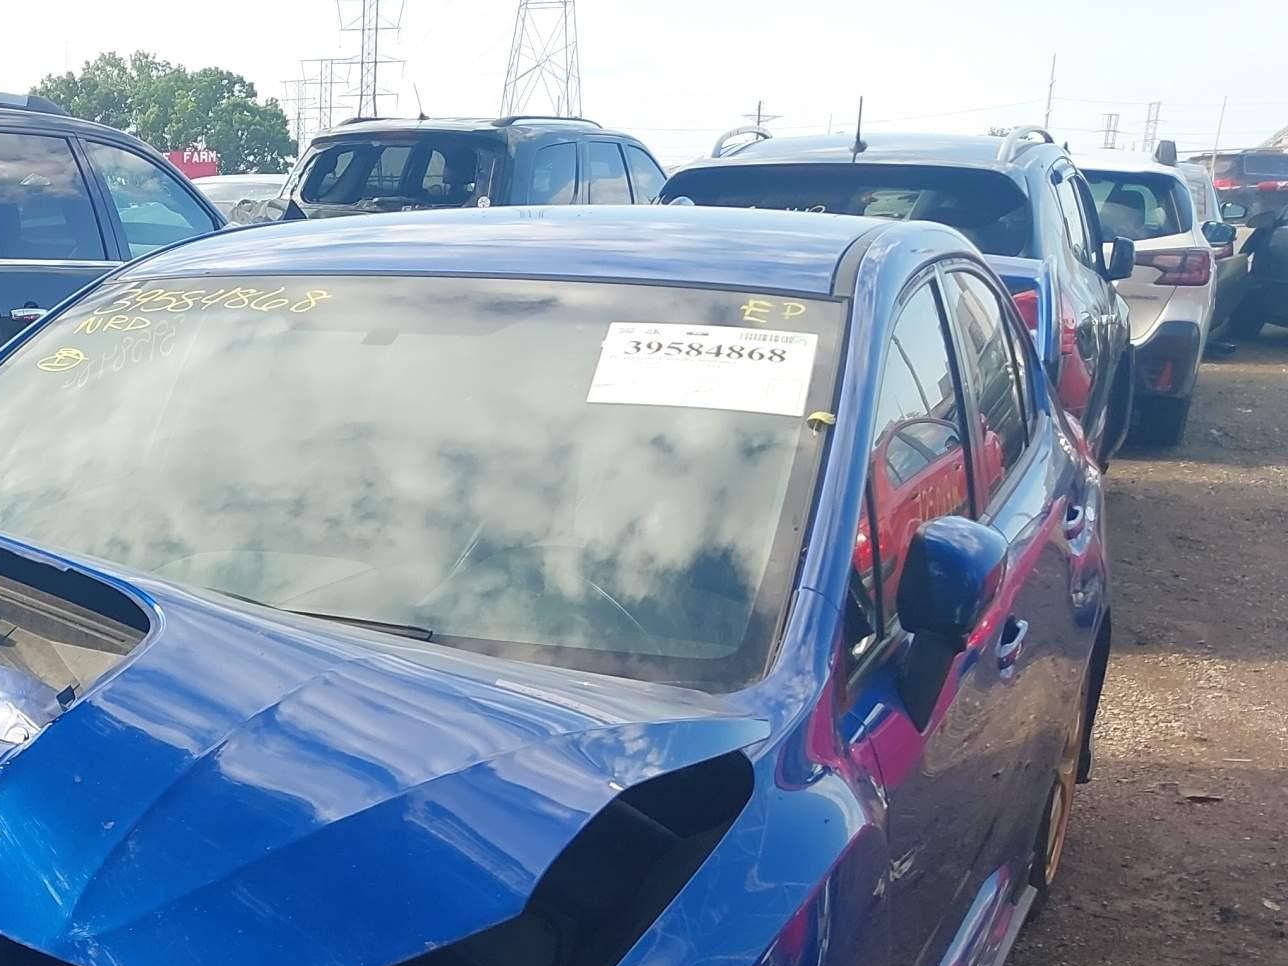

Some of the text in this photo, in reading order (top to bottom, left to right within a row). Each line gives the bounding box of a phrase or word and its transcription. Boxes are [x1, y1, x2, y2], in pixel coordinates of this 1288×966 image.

[183, 151, 217, 163] FARM
[95, 287, 332, 314] 39584868
[73, 315, 151, 335] NRD
[623, 339, 787, 364] 39584868
